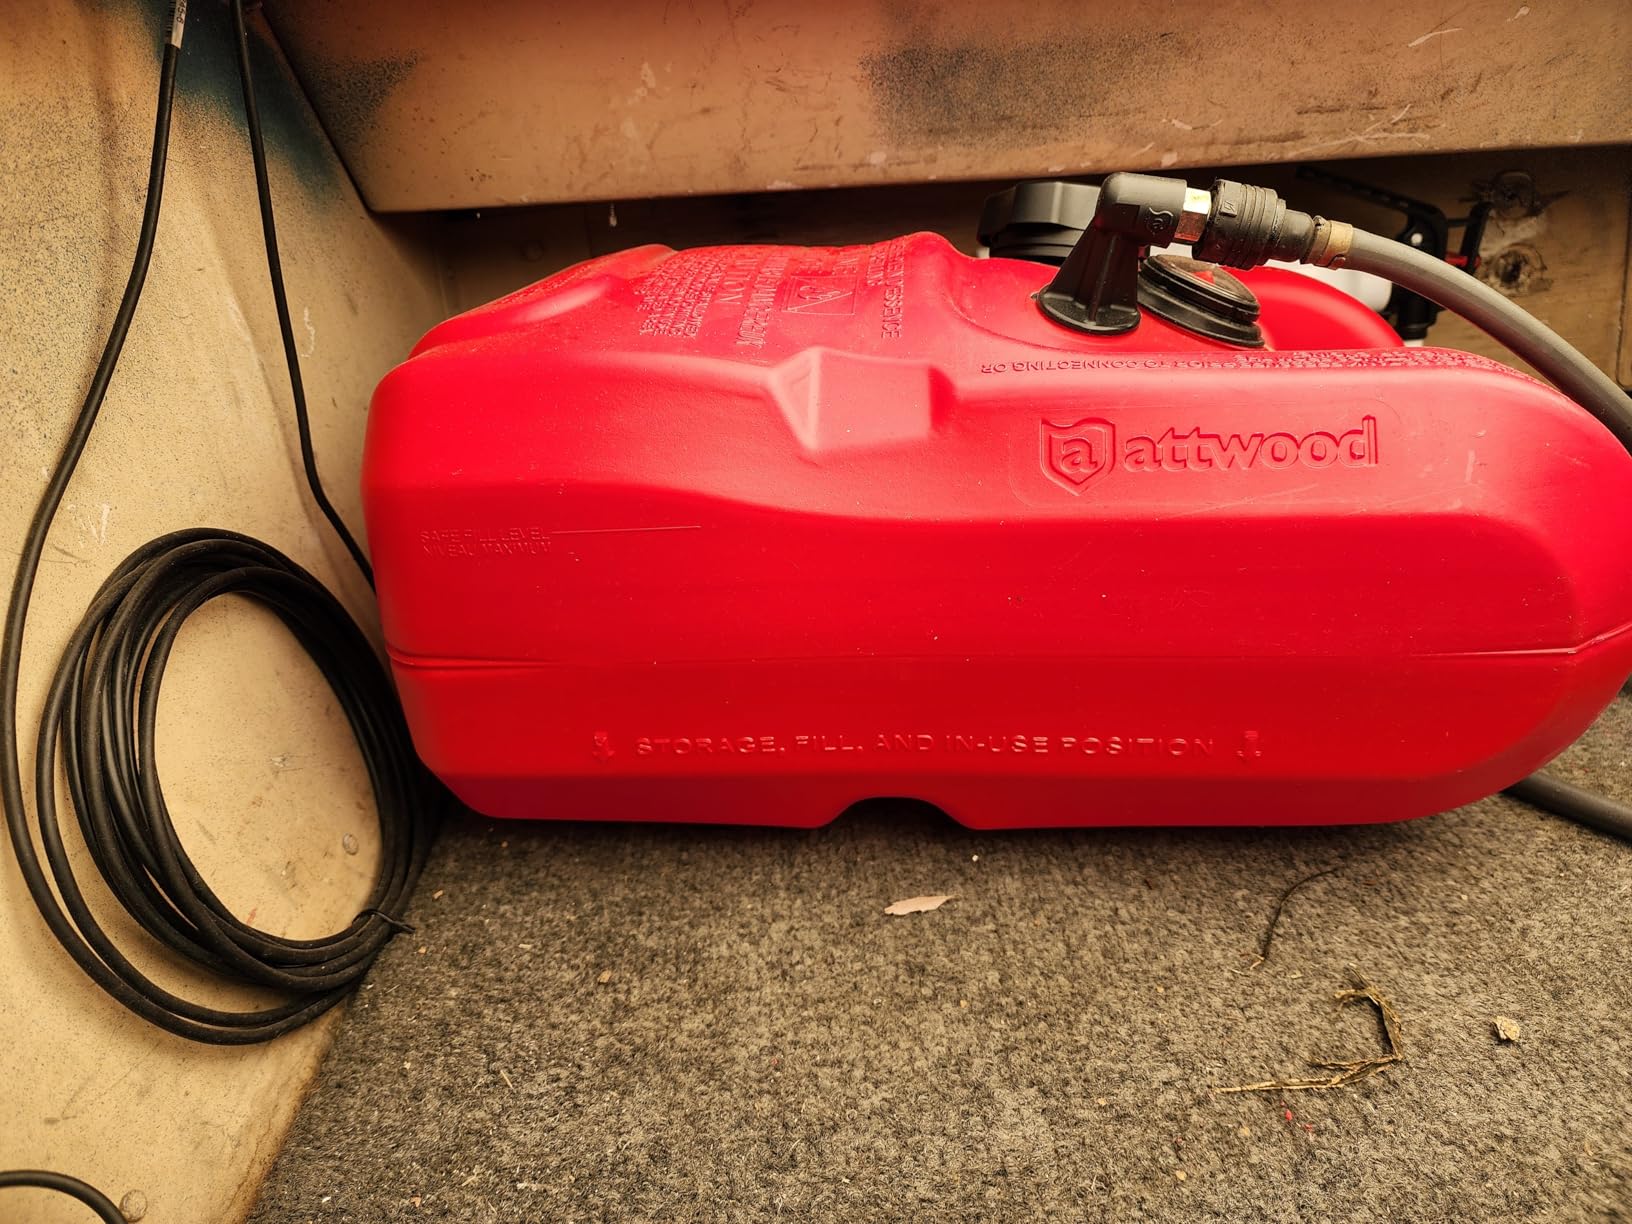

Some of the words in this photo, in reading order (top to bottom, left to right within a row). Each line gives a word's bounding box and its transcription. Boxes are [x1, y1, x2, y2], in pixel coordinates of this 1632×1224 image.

[981, 362, 1007, 373] OR
[1011, 359, 1138, 371] CONNECTING
[1123, 415, 1379, 473] attwood
[875, 733, 935, 751] AND
[945, 734, 1049, 753] IN-USE
[1060, 735, 1214, 756] POSITION
